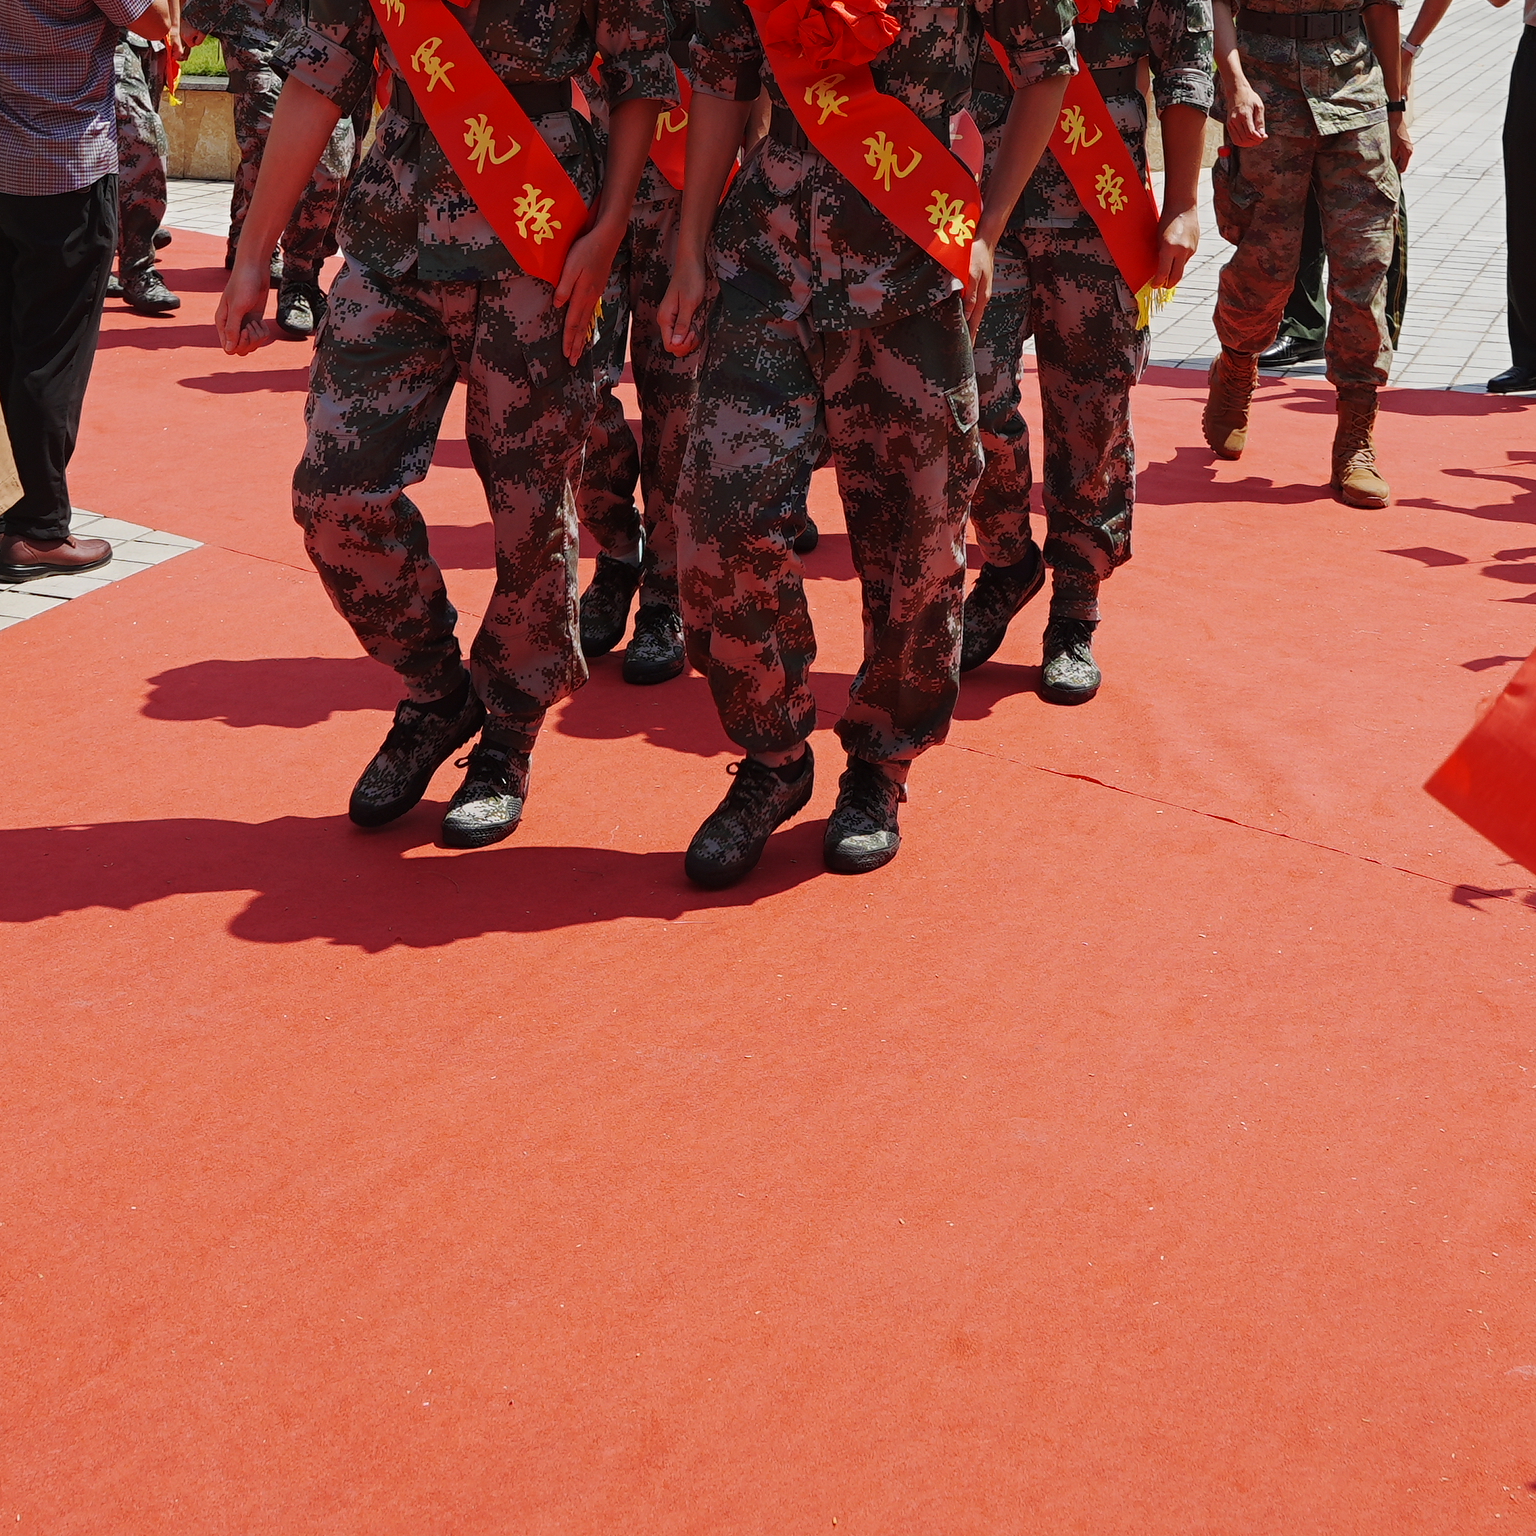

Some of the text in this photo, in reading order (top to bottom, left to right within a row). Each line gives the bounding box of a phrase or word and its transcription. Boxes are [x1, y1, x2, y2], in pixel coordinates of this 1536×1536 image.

[803, 73, 976, 247] 军光荣
[1060, 105, 1129, 215] 光荣
